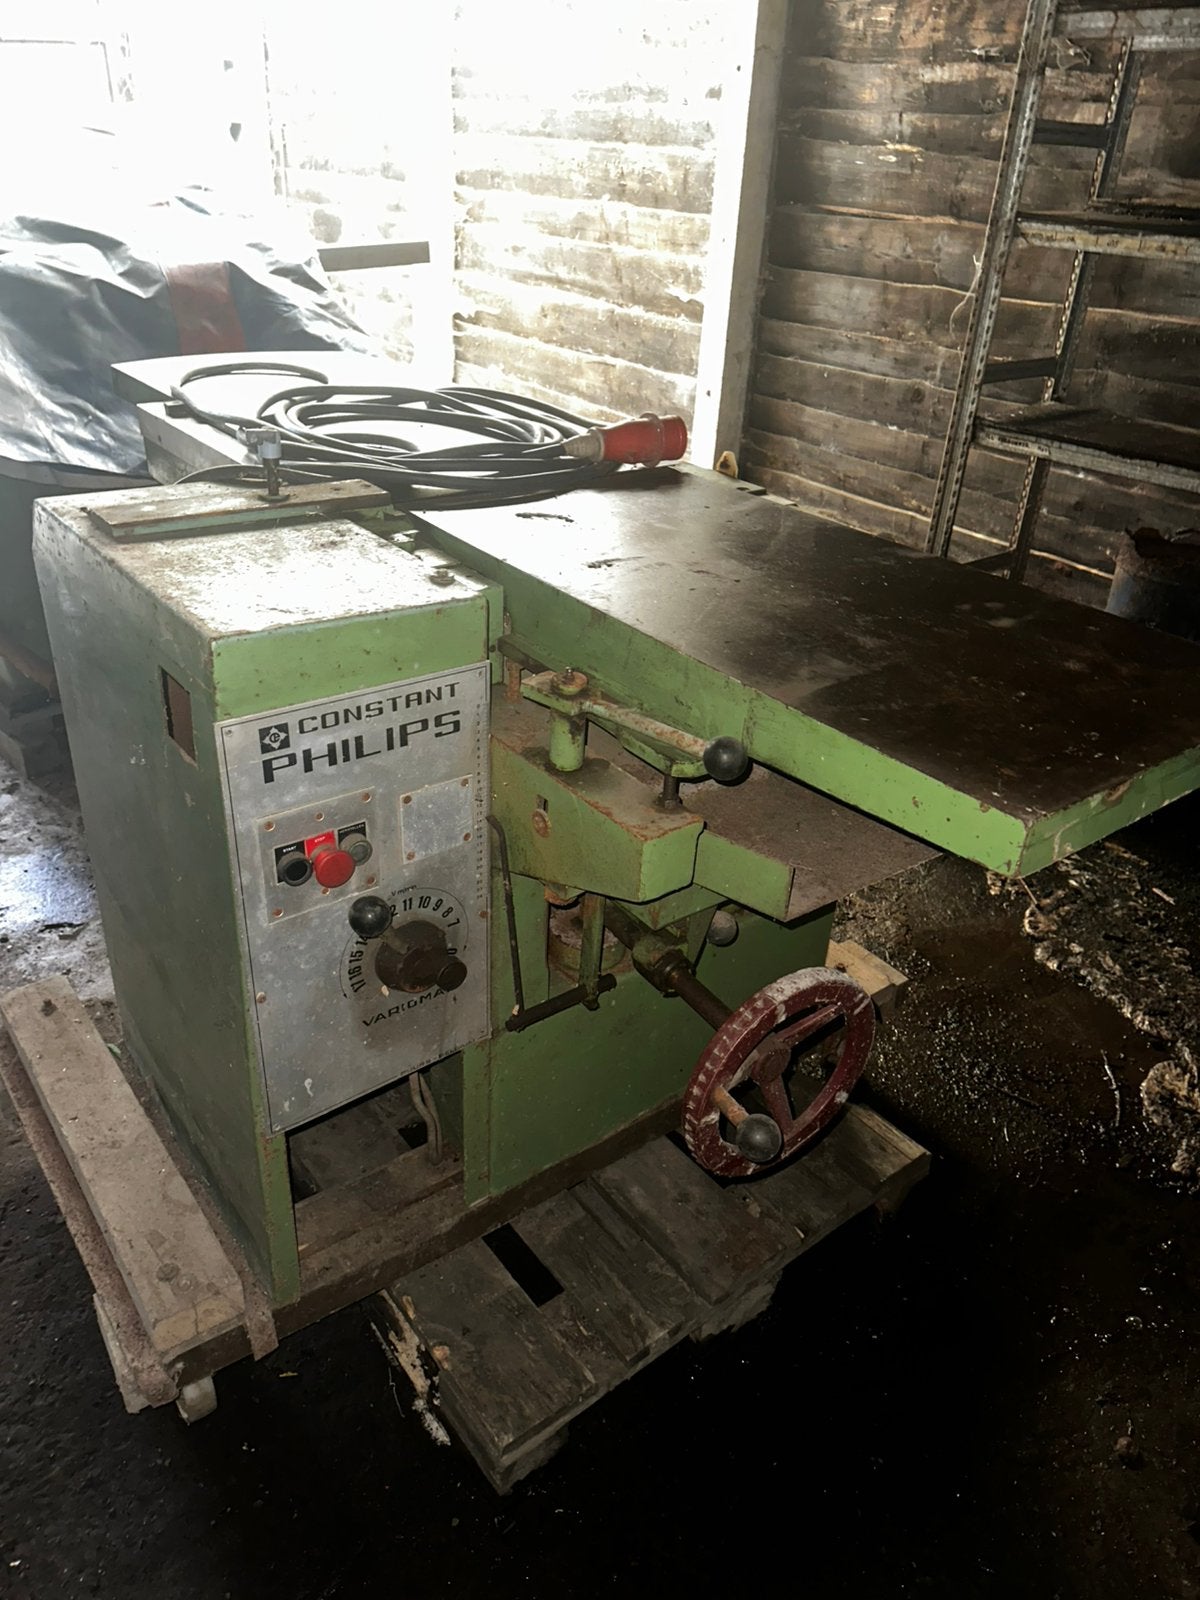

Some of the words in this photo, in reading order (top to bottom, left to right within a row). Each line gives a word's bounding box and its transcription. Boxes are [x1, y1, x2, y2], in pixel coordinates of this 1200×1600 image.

[298, 682, 460, 734] CONSTANT
[261, 710, 461, 784] PHILIPS
[402, 897, 413, 911] 11
[417, 895, 432, 909] 10
[432, 898, 443, 911] 9
[441, 906, 454, 918] 8
[447, 917, 460, 928] 7
[349, 950, 364, 963] 15
[348, 965, 362, 980] 16
[362, 988, 447, 1027] VARIOMA
